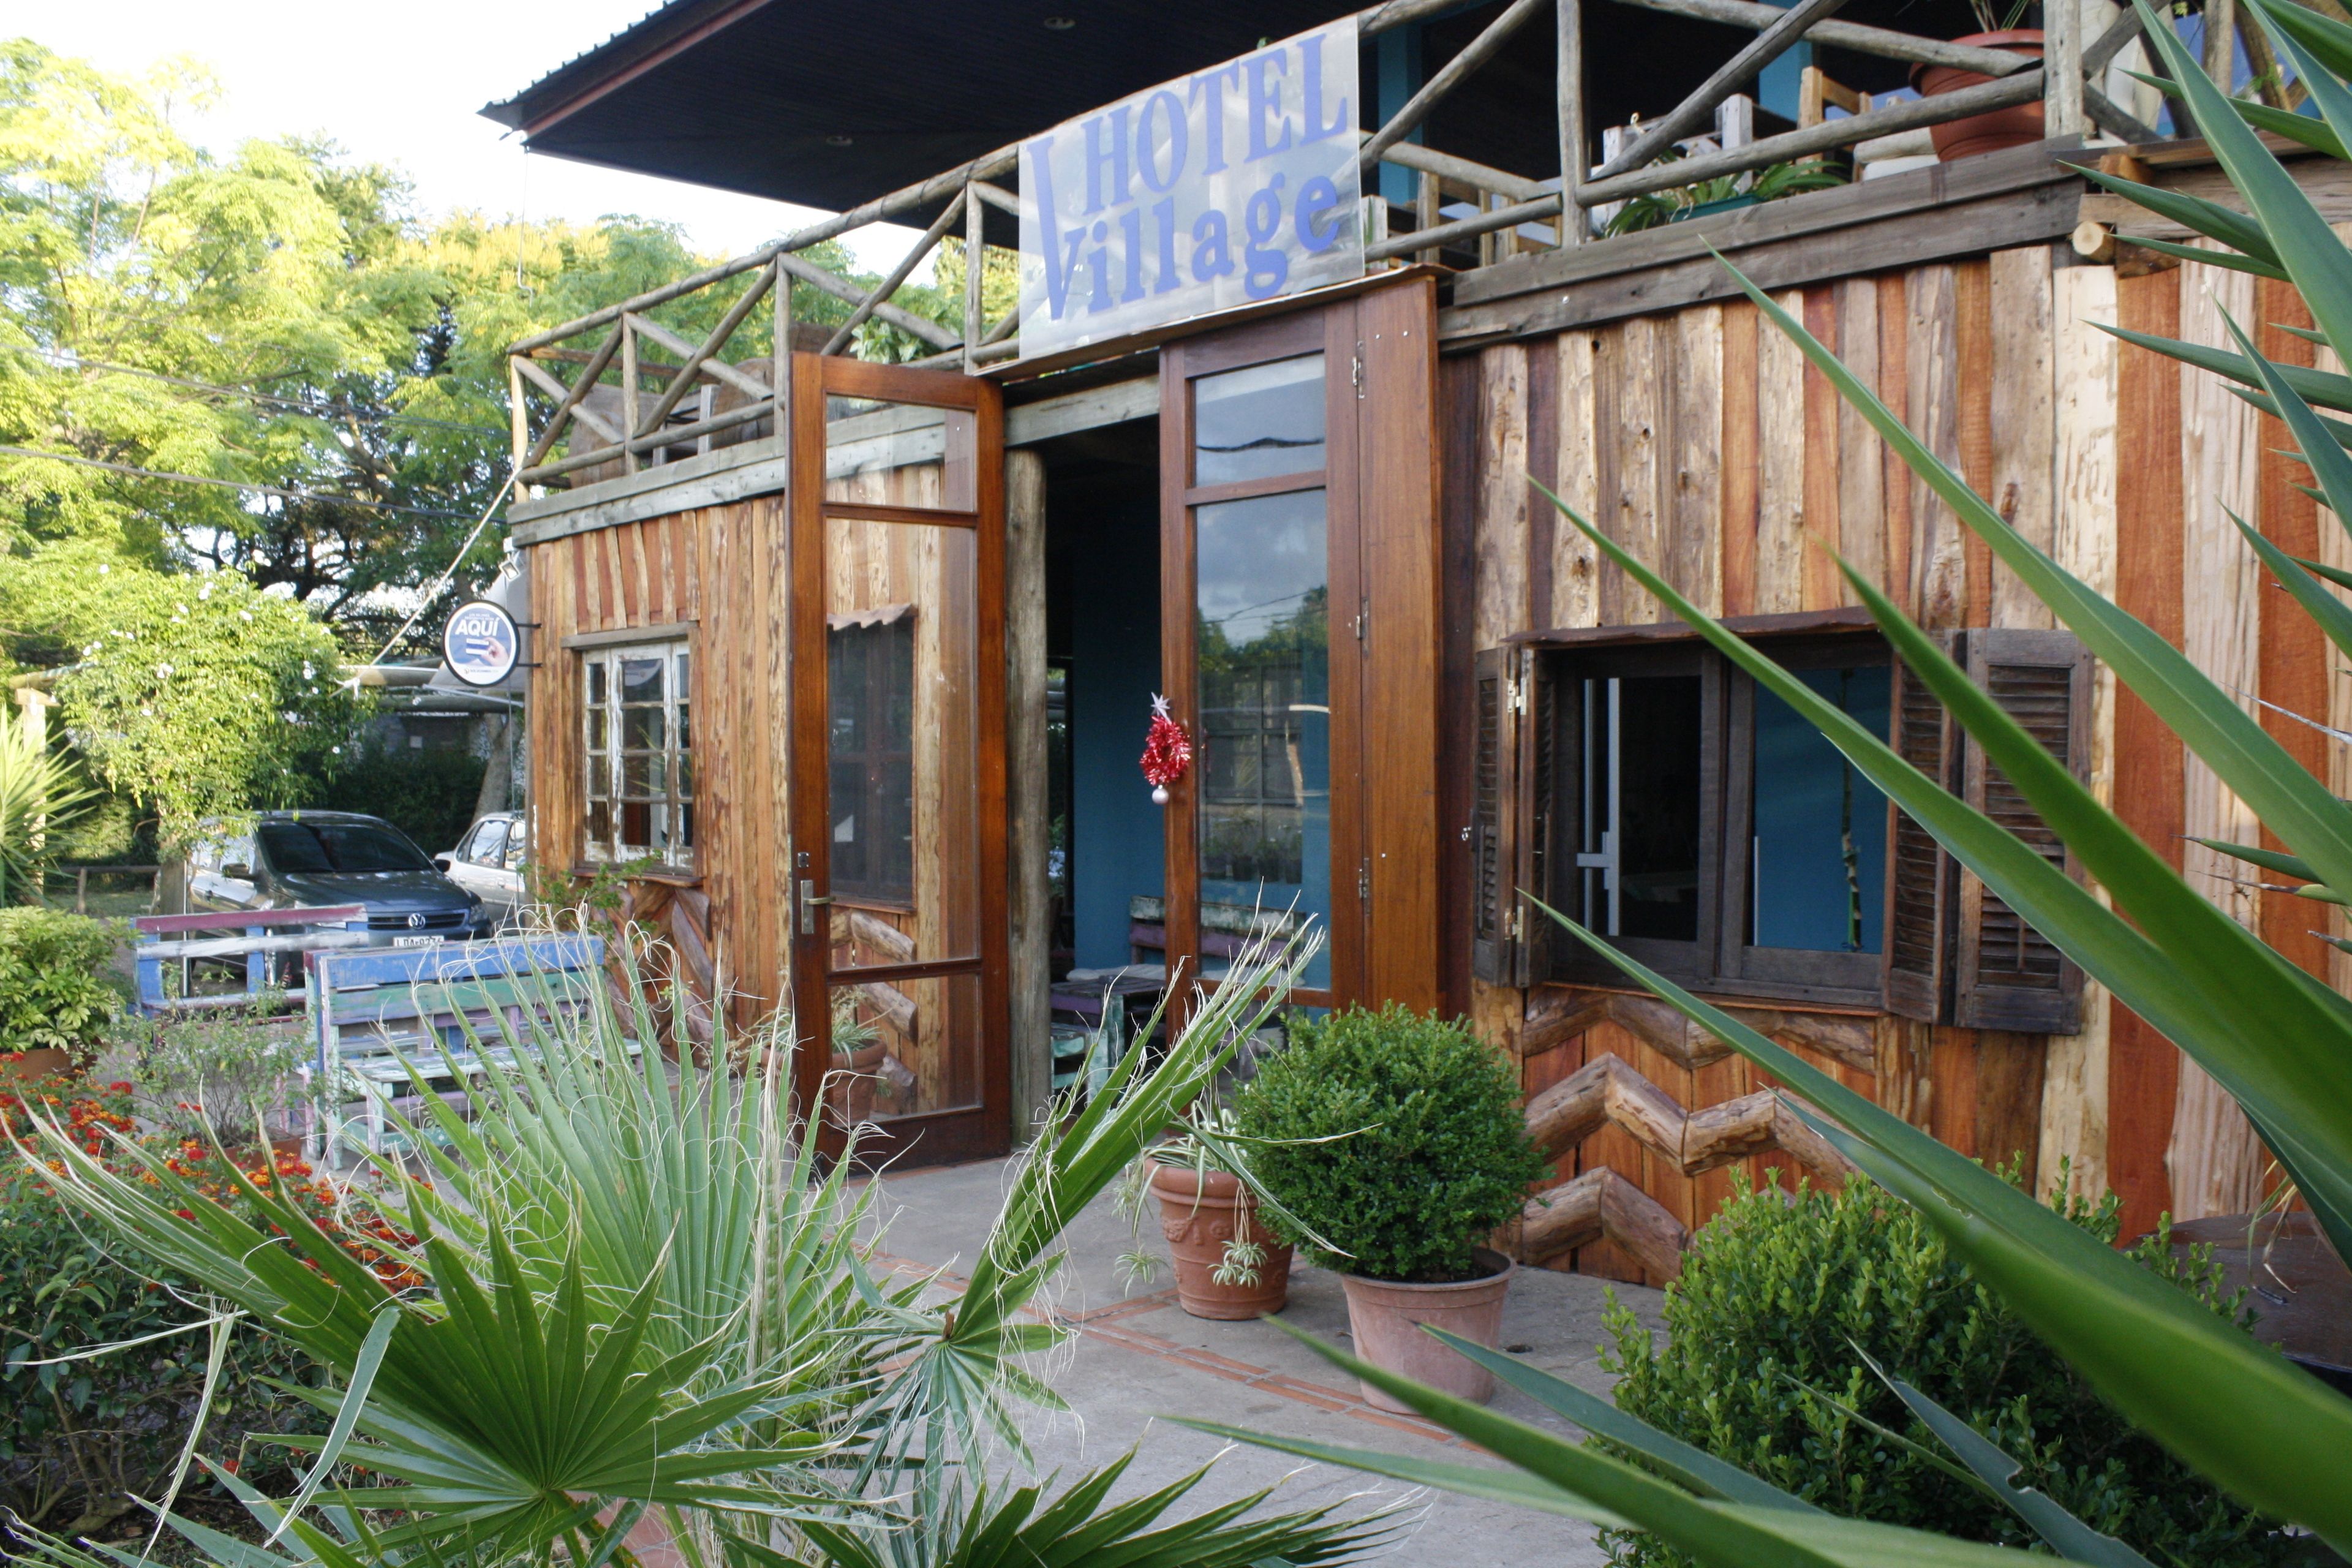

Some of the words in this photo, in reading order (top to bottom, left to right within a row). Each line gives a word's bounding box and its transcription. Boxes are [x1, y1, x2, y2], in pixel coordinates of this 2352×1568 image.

[1080, 33, 1348, 217] HOTEL
[1027, 136, 1341, 322] Village
[454, 617, 500, 637] AQUÍ
